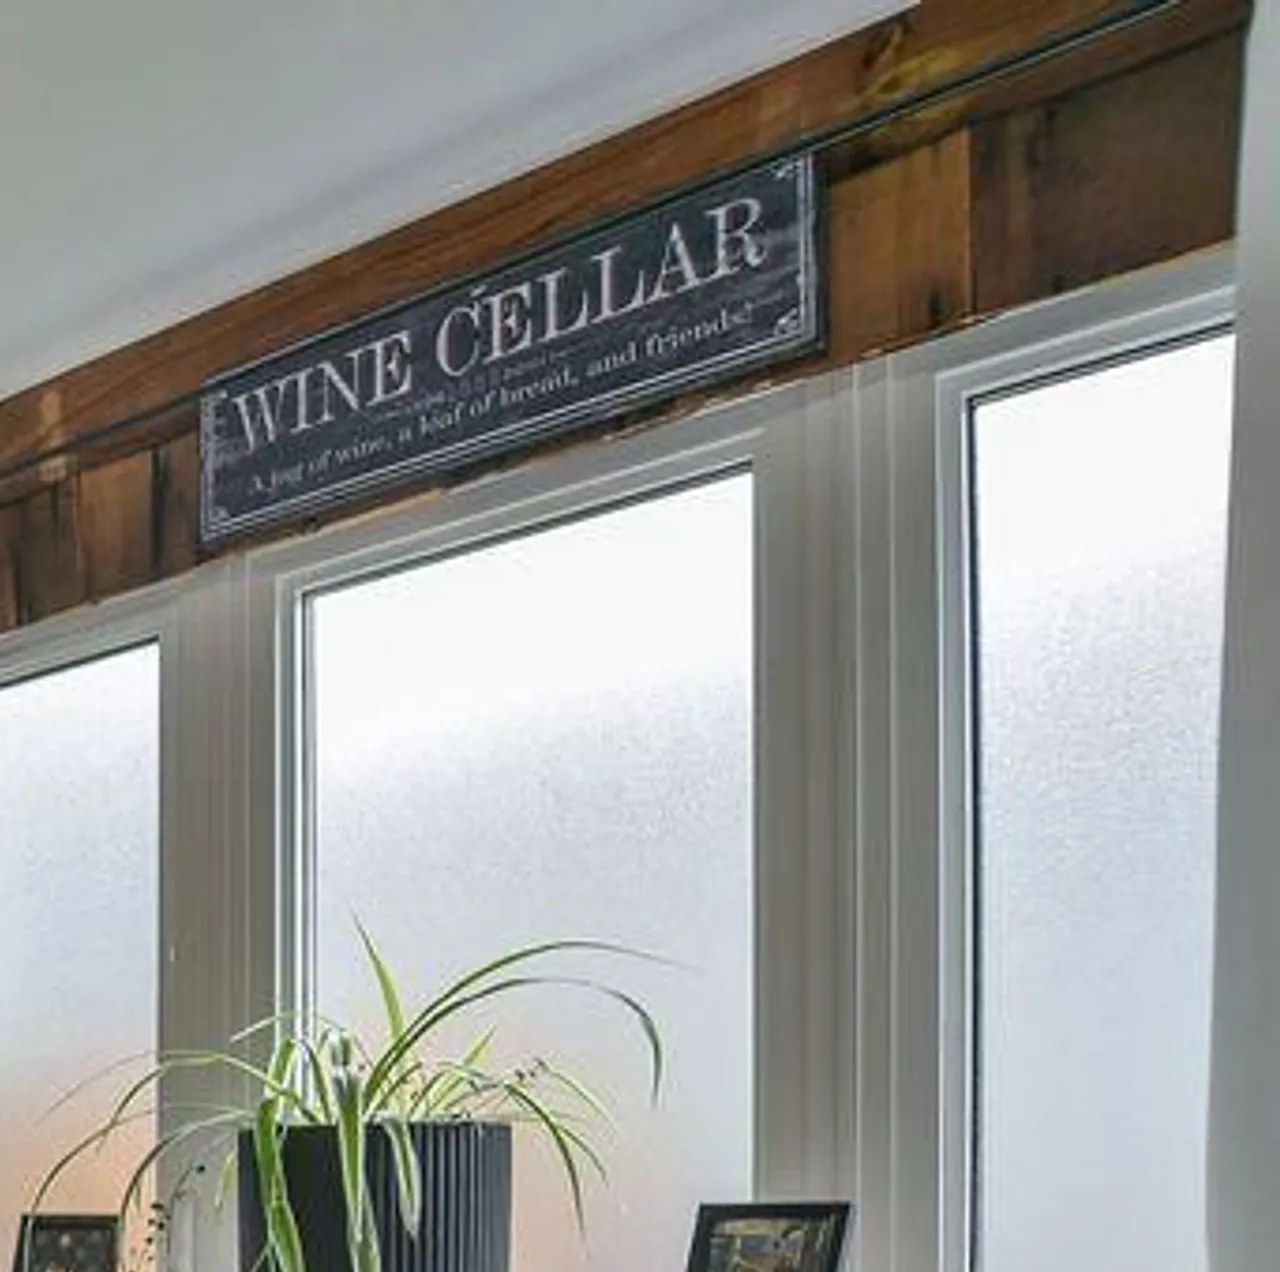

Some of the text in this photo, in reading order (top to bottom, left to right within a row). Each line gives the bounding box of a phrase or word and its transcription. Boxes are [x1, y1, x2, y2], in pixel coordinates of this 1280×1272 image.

[231, 197, 768, 452] WINE CELLAR
[468, 389, 496, 417] of
[586, 341, 638, 377] and
